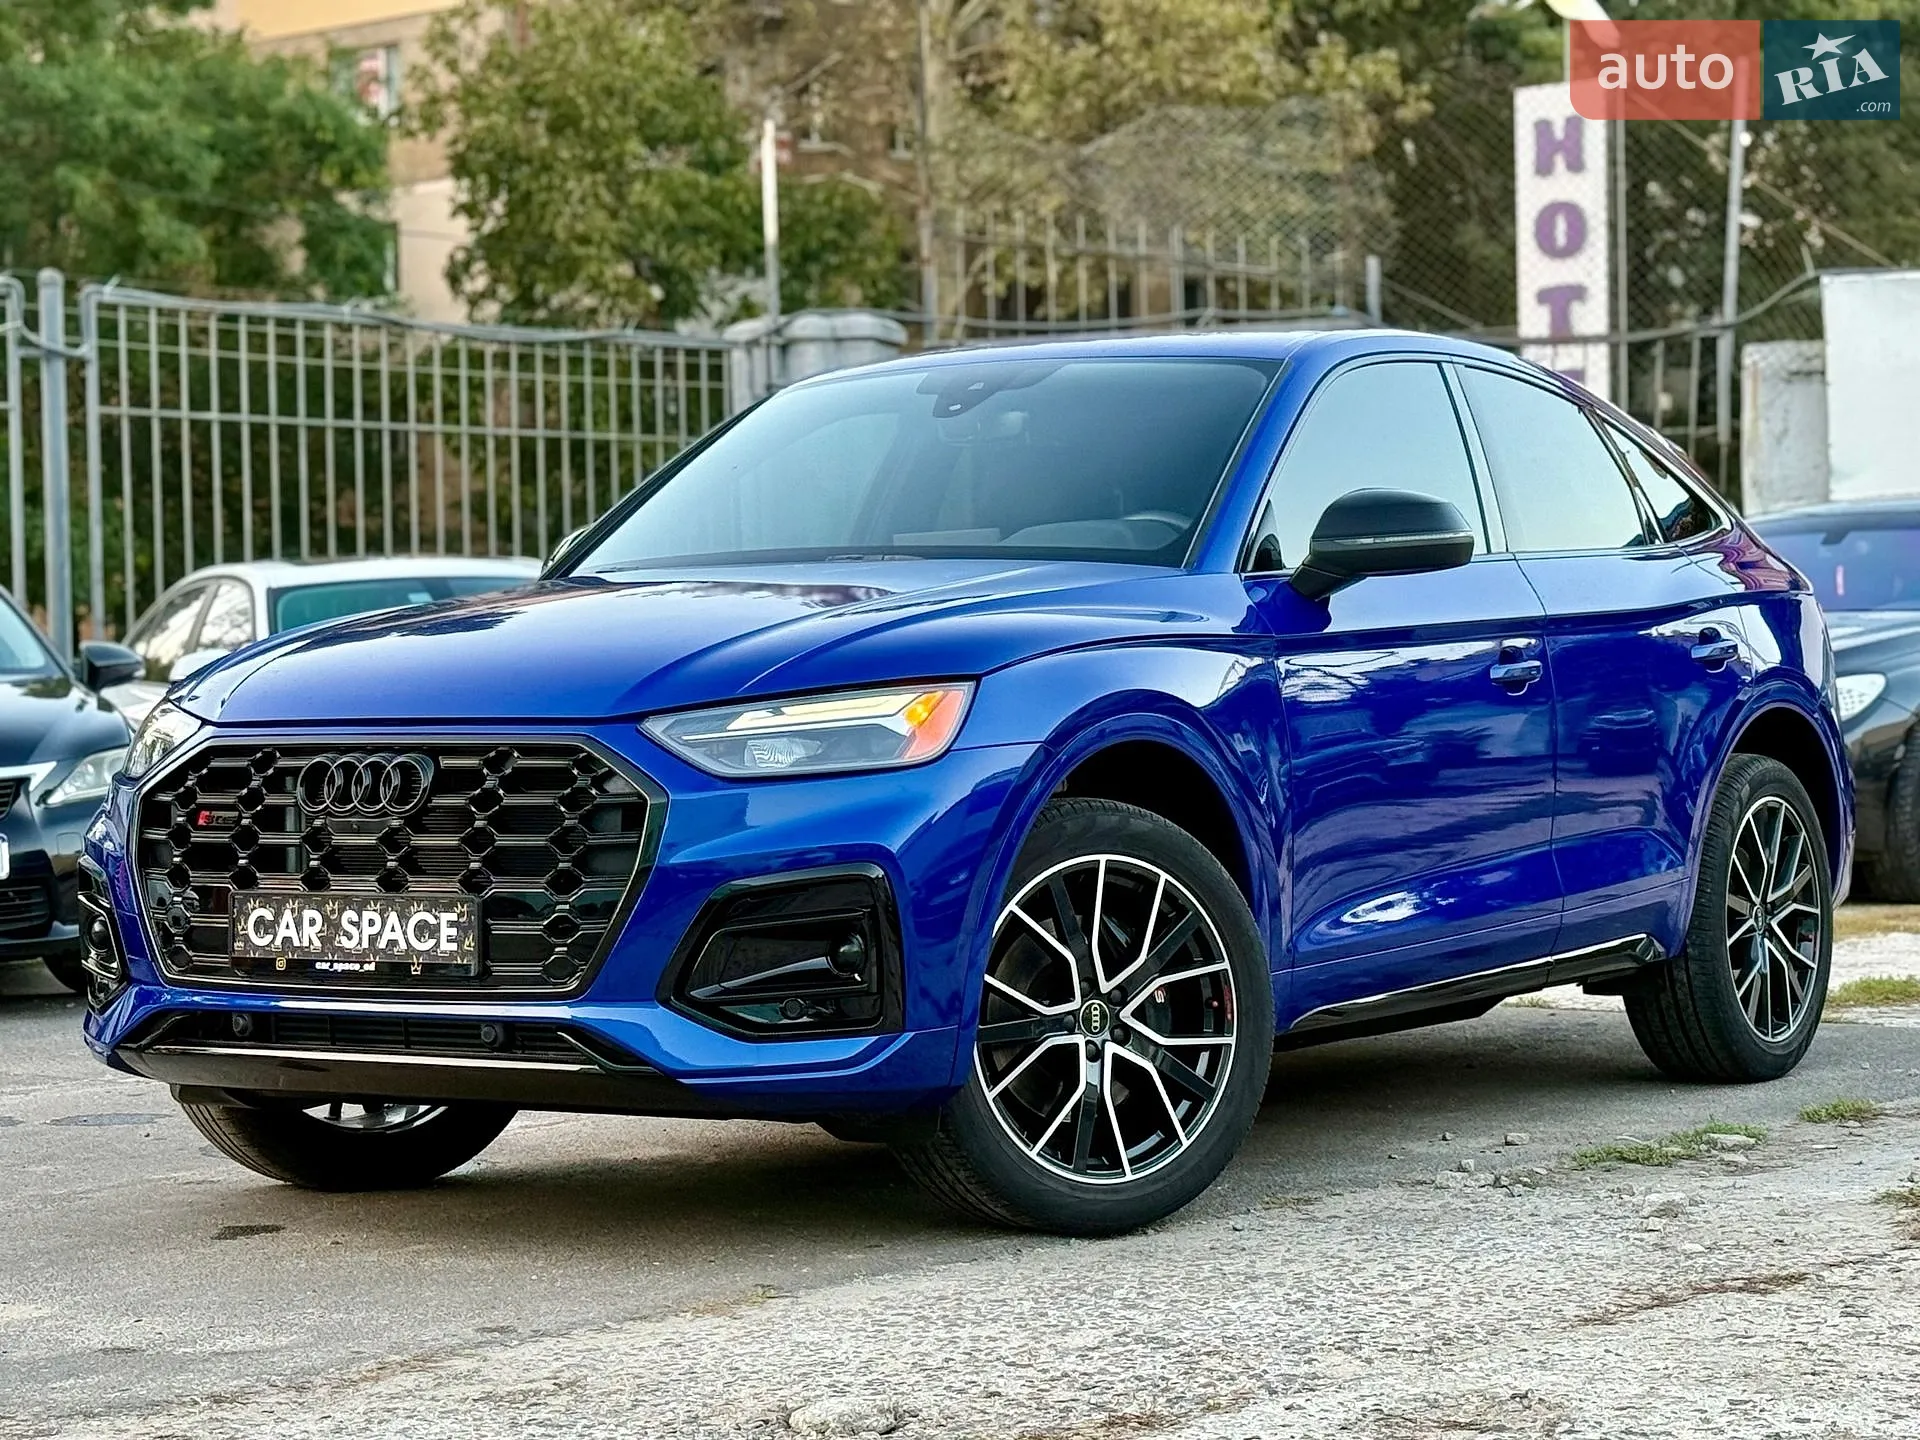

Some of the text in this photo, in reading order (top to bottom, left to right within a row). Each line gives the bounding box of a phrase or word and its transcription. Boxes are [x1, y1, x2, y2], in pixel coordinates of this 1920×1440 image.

[1534, 115, 1587, 384] HOT
[247, 907, 458, 951] CAR SPACE
